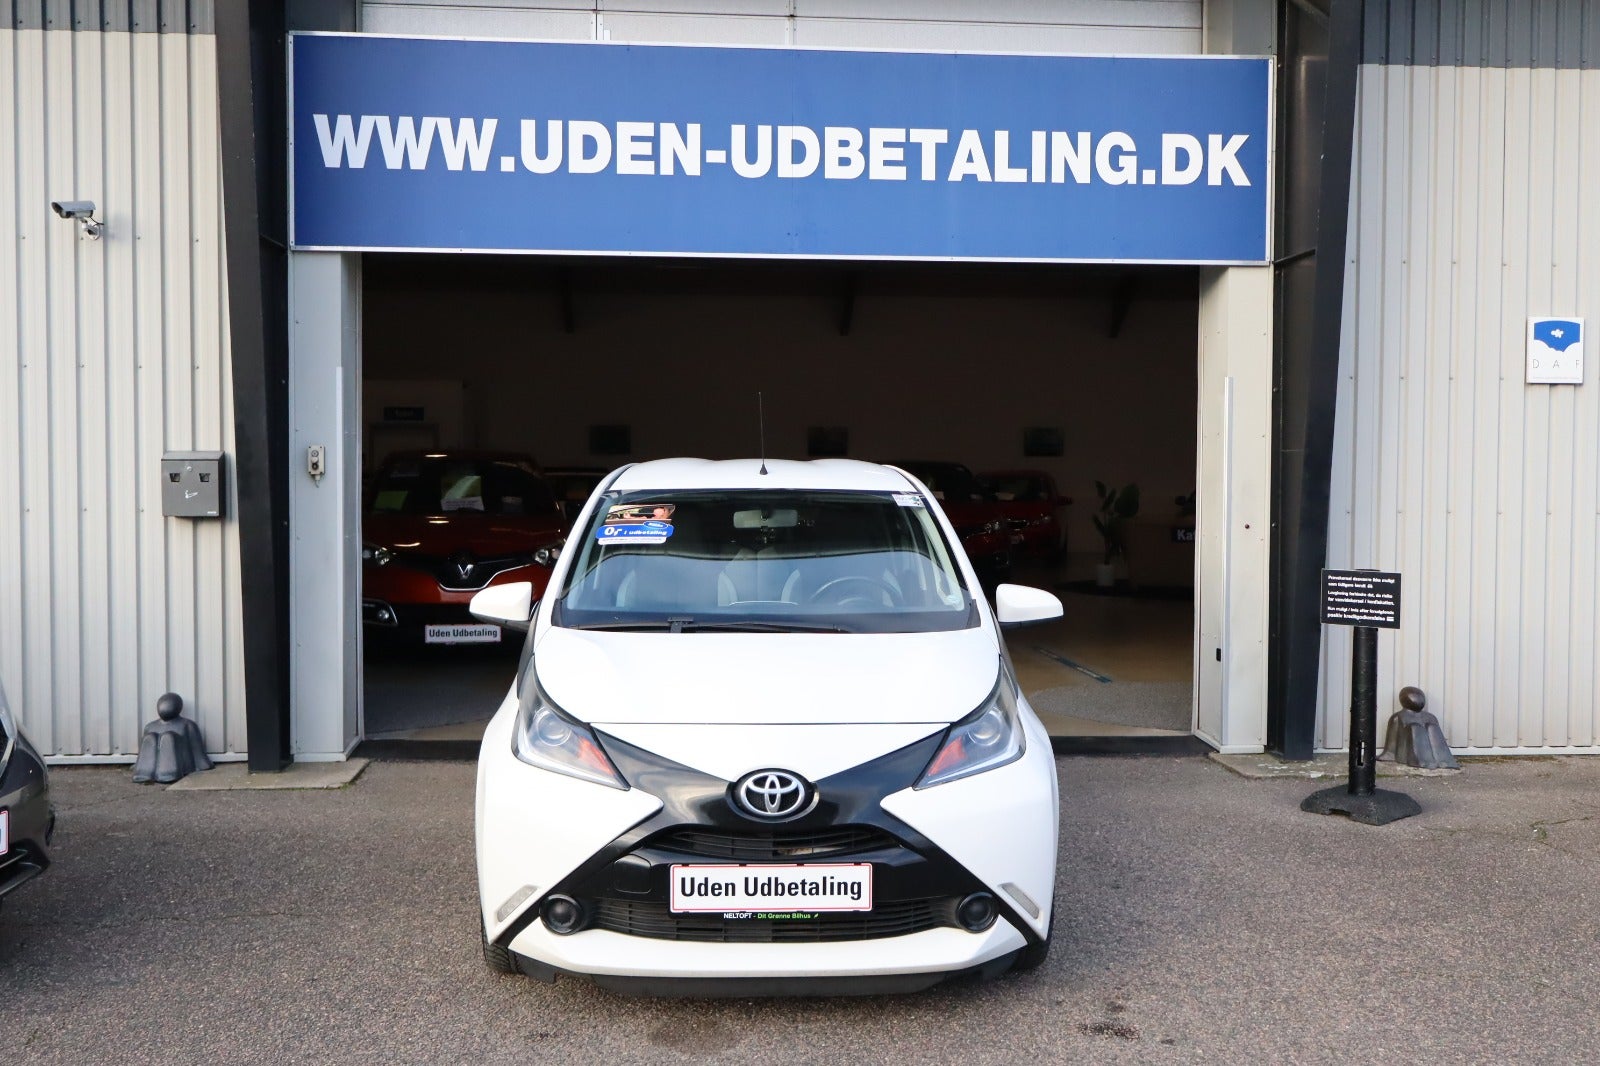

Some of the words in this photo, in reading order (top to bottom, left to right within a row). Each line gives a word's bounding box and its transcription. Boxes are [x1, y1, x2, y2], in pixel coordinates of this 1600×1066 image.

[312, 114, 1251, 186] WWW.UDEN-UDBETALING.DK
[429, 629, 450, 637] Uden
[453, 628, 498, 638] Udbetaling
[681, 877, 736, 897] Uden
[744, 876, 862, 900] Udbetaling
